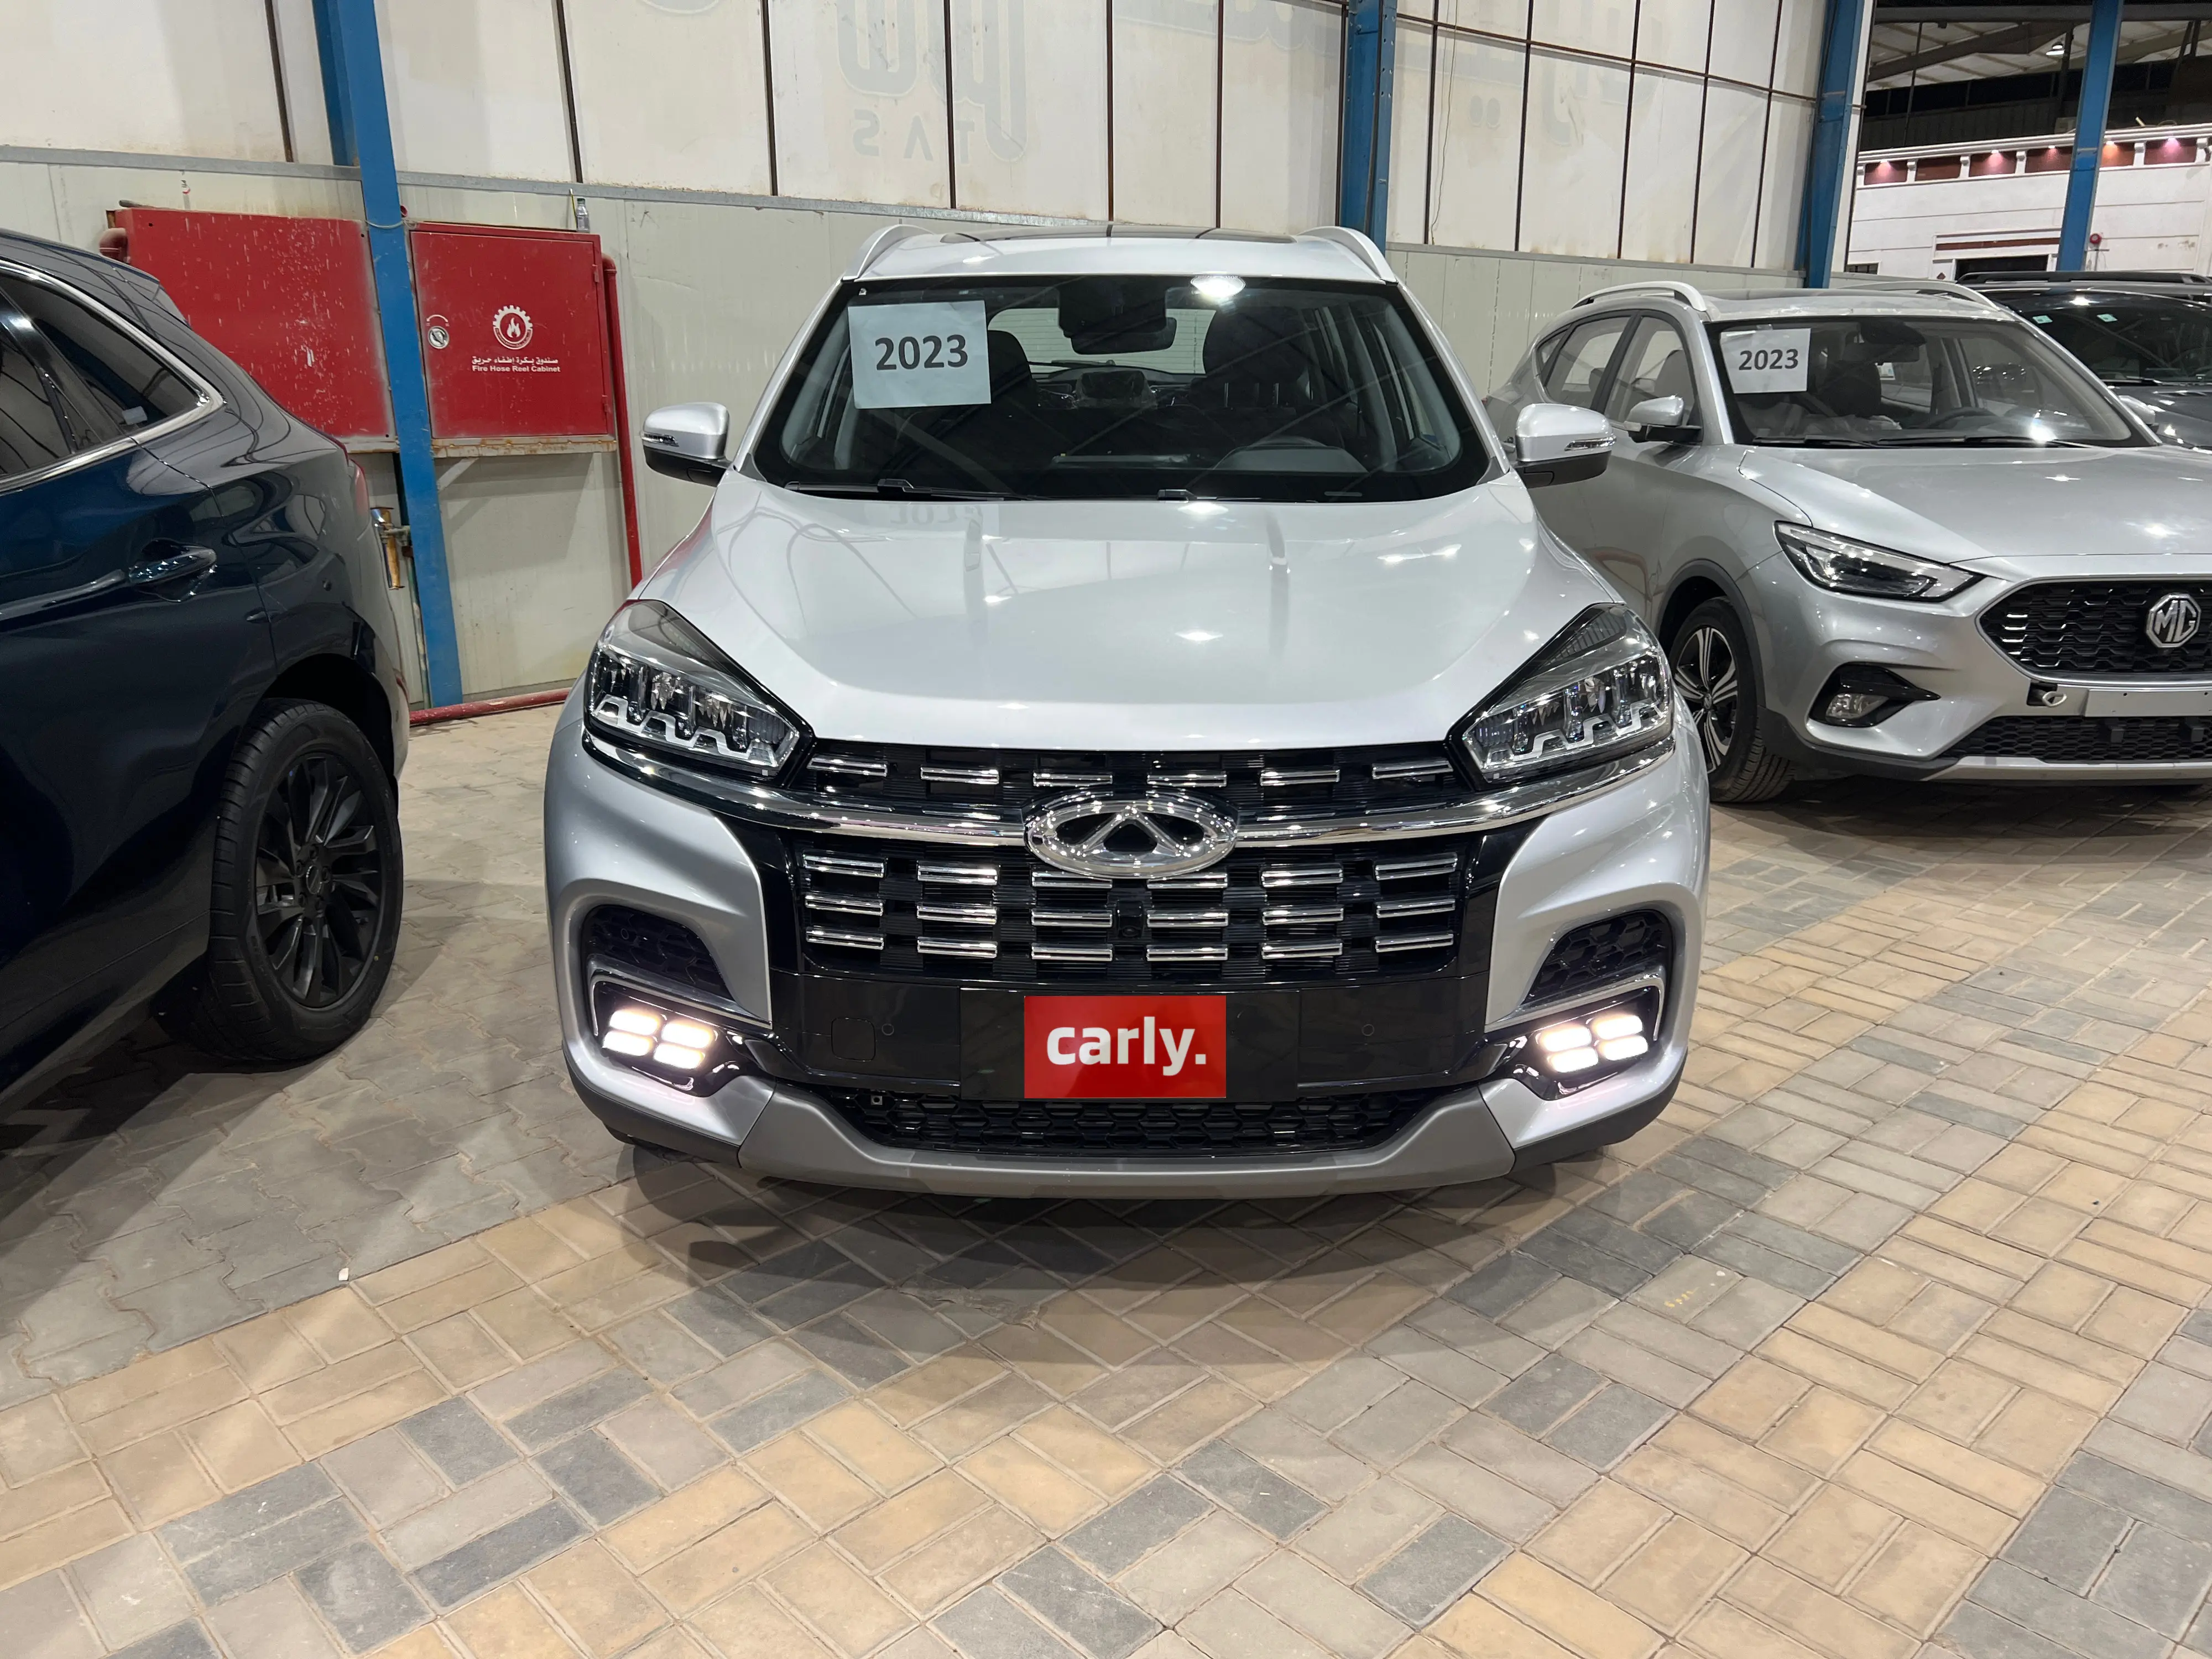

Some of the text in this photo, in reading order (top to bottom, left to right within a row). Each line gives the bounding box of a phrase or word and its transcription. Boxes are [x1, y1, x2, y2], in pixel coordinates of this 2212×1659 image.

[471, 356, 492, 365] حريق
[535, 356, 559, 365] صندوق
[874, 333, 968, 371] 2023
[1738, 348, 1799, 371] 2023
[2155, 599, 2197, 643] MG
[1046, 1016, 1207, 1076] carly.
